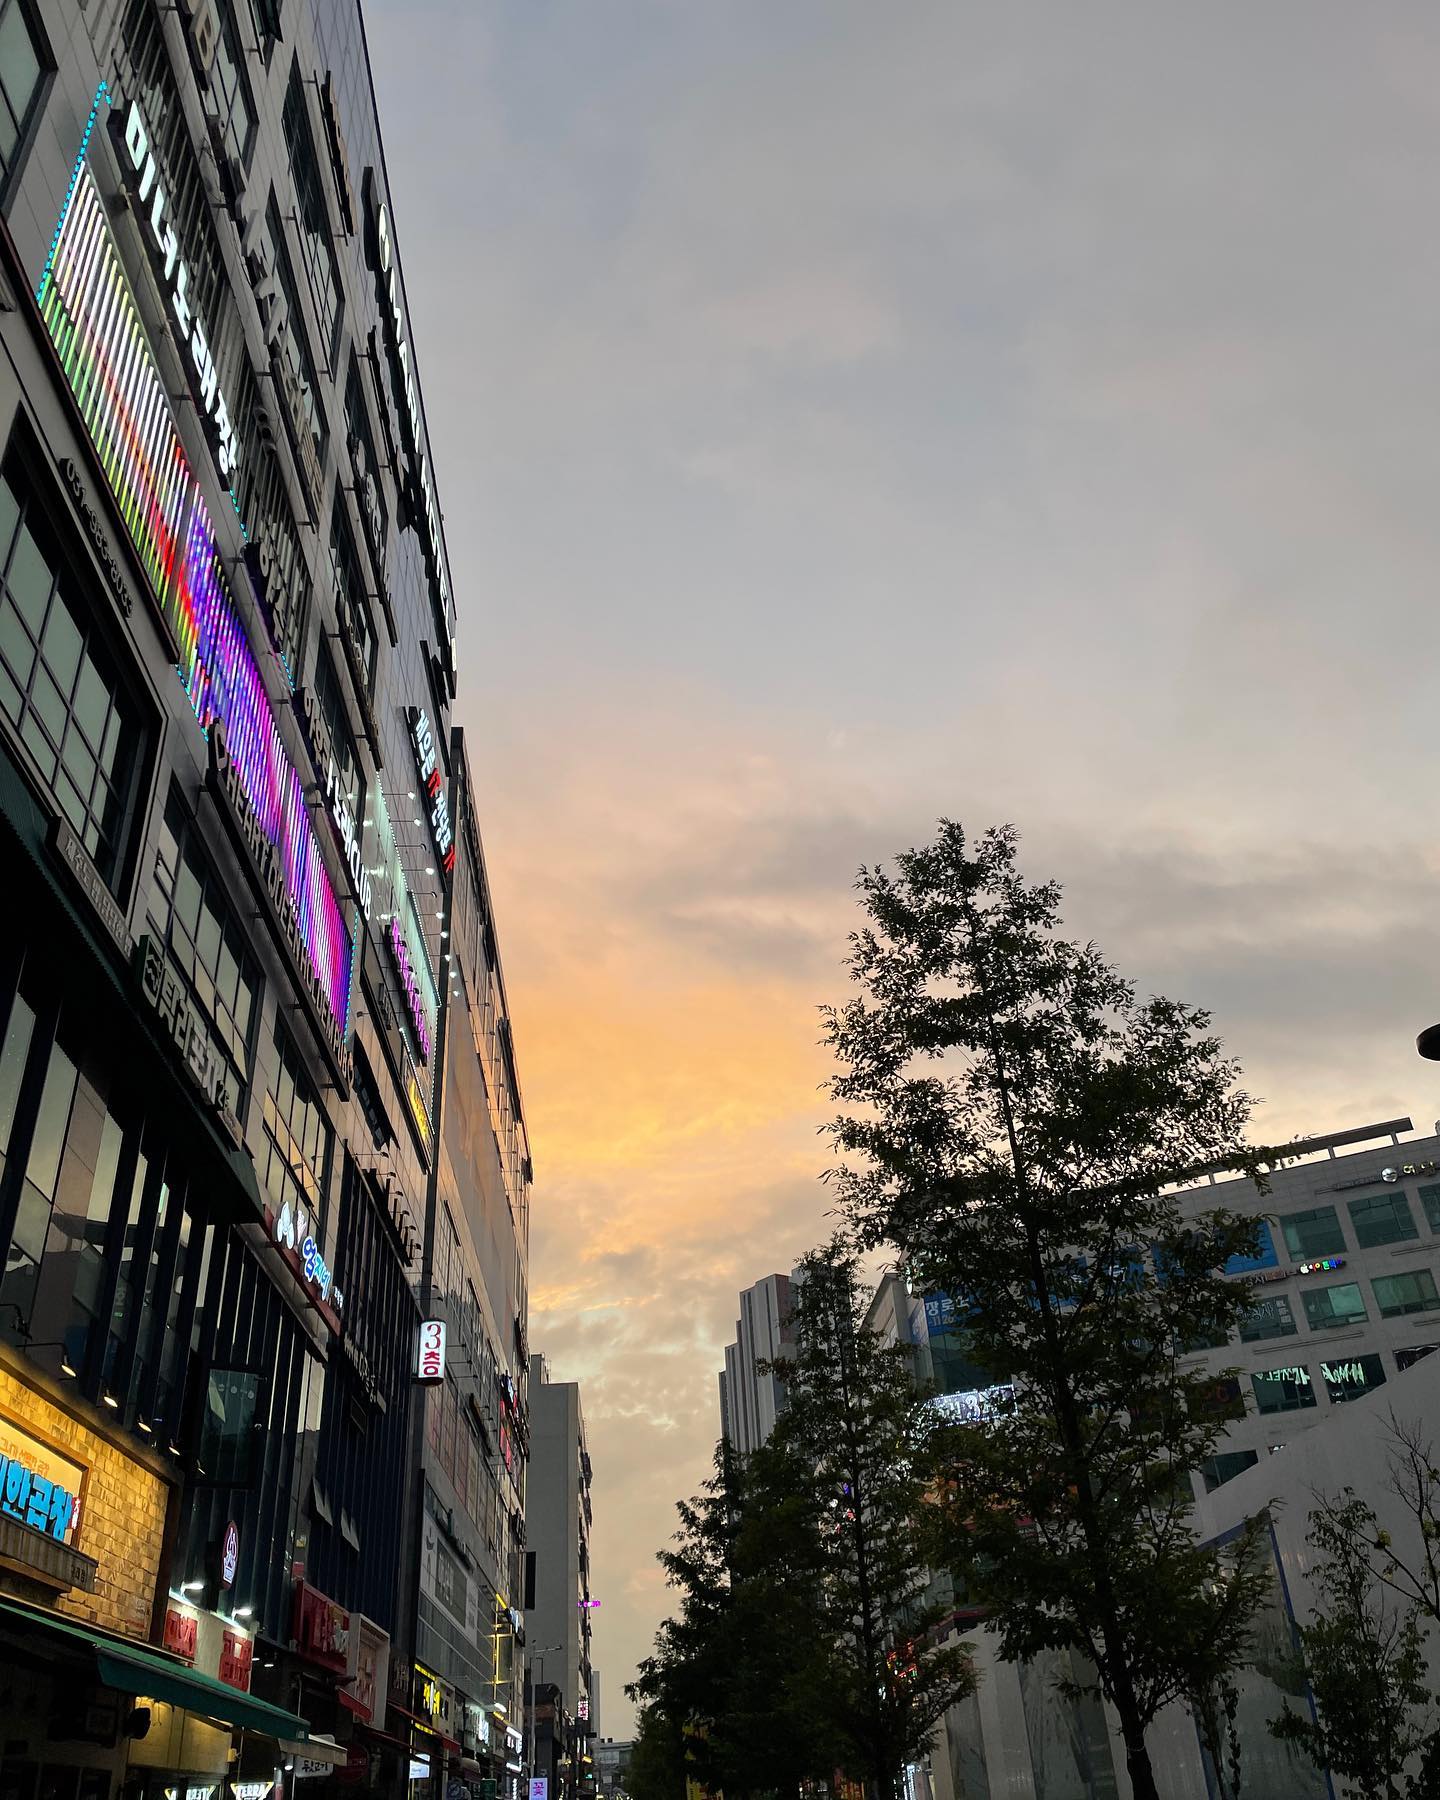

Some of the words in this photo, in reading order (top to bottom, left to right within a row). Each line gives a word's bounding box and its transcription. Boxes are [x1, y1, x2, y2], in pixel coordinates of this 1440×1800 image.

[224, 761, 271, 879] HEART
[423, 1323, 442, 1376] 3층
[237, 1783, 264, 1798] TERRA
[532, 1781, 545, 1797] 꽃
